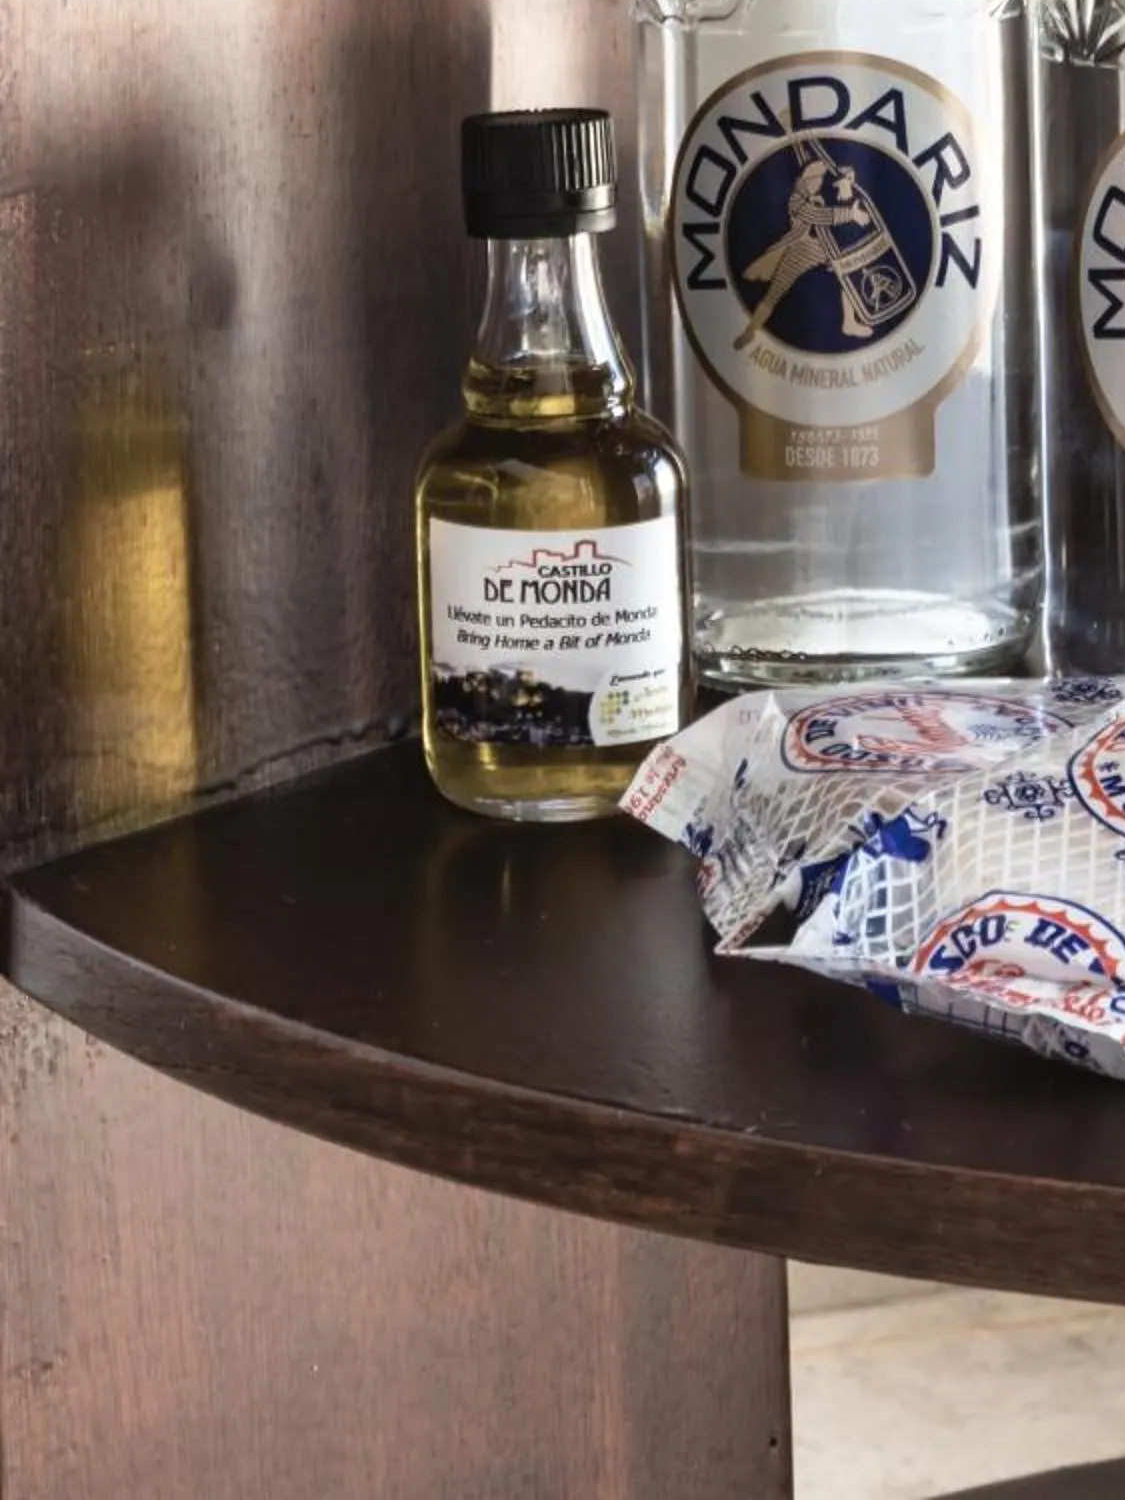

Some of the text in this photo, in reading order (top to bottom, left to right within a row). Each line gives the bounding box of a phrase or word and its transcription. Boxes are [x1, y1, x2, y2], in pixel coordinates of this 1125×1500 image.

[678, 76, 982, 290] MONDARIZ
[748, 337, 926, 389] AGUA MINERAL NATURAL
[785, 446, 836, 469] DESDE
[537, 562, 613, 579] CASTILLO
[483, 576, 612, 605] DE MONDA
[496, 614, 515, 628] un
[519, 613, 587, 629] Pedacito
[591, 611, 611, 627] de
[614, 604, 658, 626] Monda
[456, 629, 491, 651] Bring
[493, 632, 541, 650] Home
[543, 638, 555, 651] a
[559, 634, 582, 650] Bit
[585, 631, 603, 649] of
[1023, 916, 1091, 966] DE
